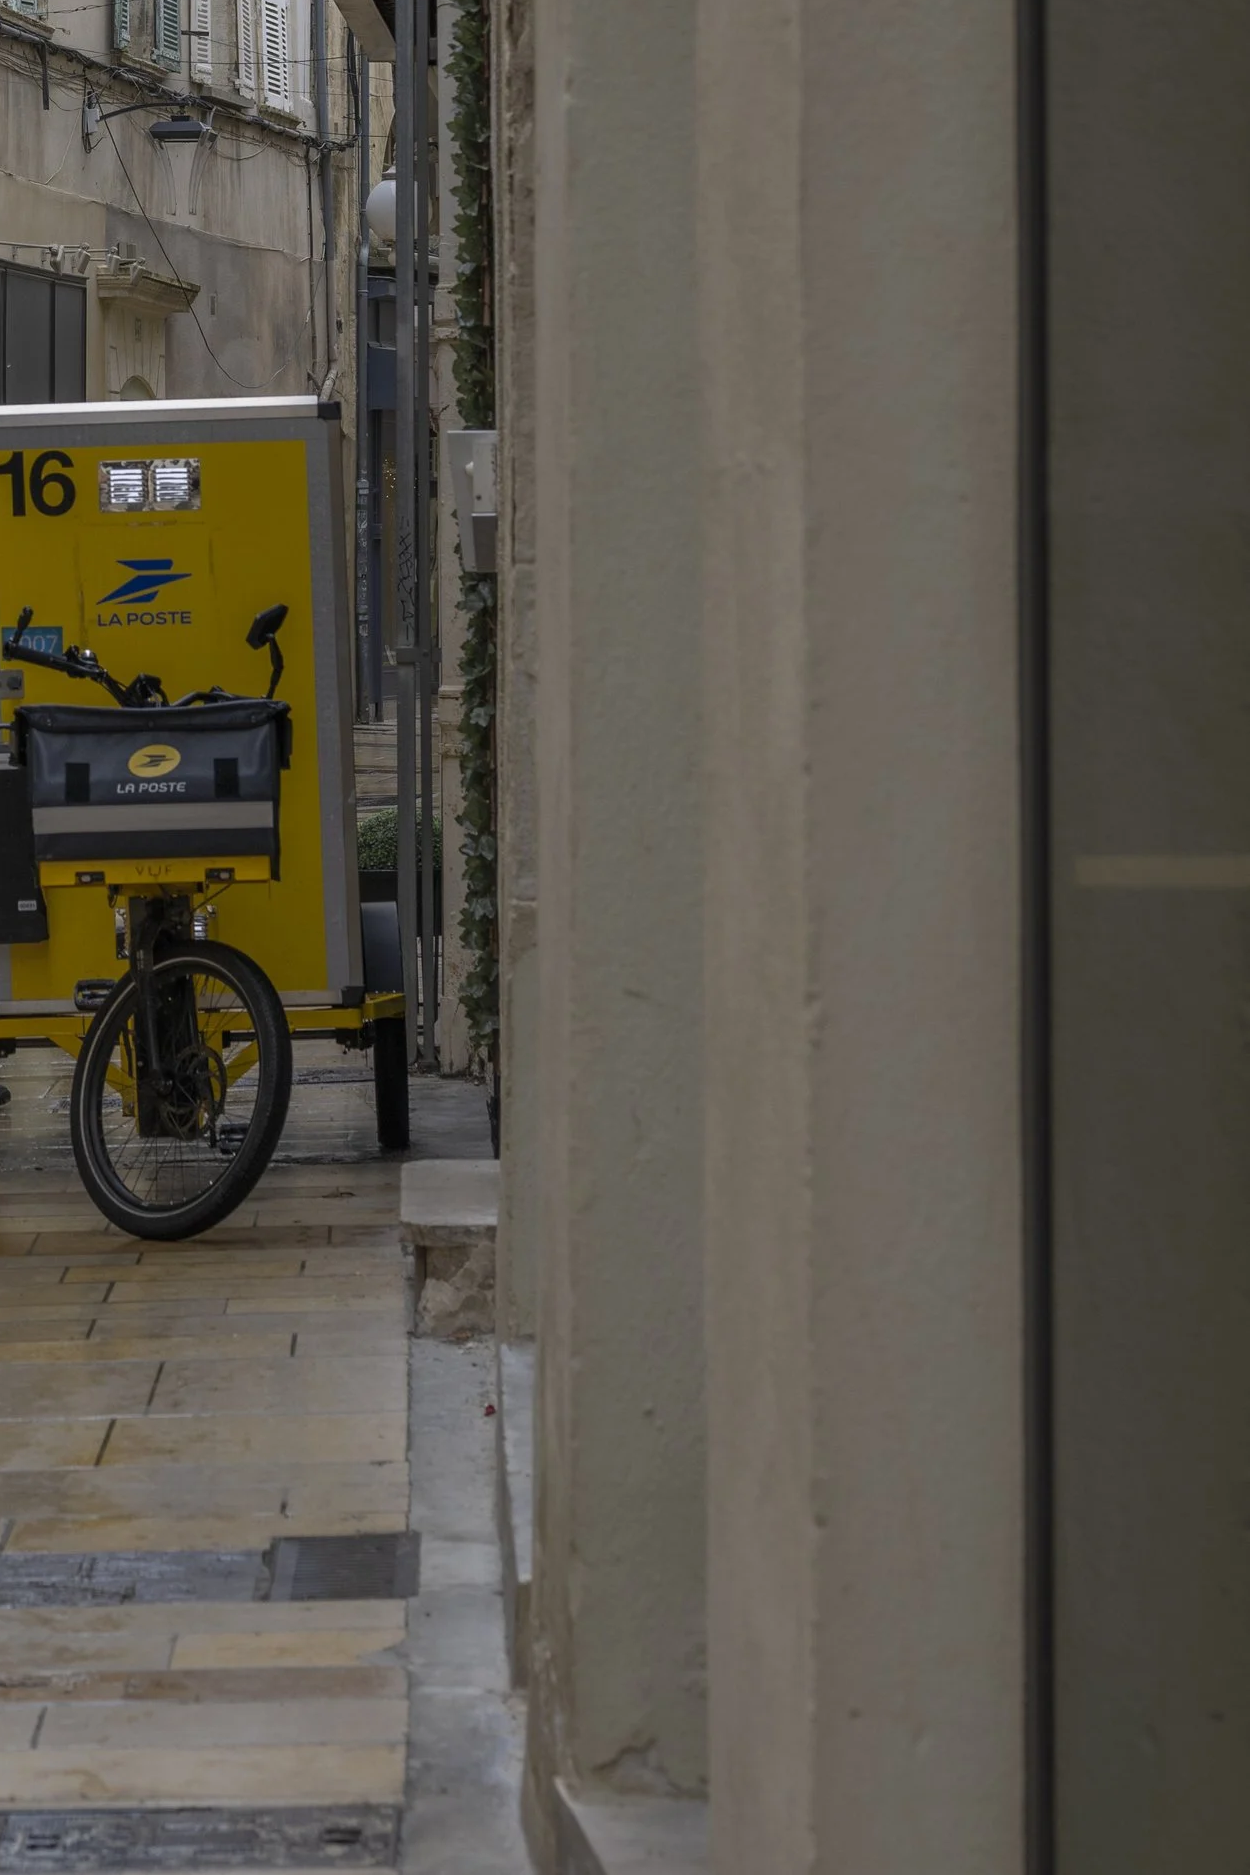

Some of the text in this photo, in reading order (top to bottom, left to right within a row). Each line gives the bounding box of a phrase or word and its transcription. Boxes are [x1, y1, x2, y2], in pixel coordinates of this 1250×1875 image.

[97, 612, 192, 626] LA POSTE
[116, 781, 186, 794] LA POSTE
